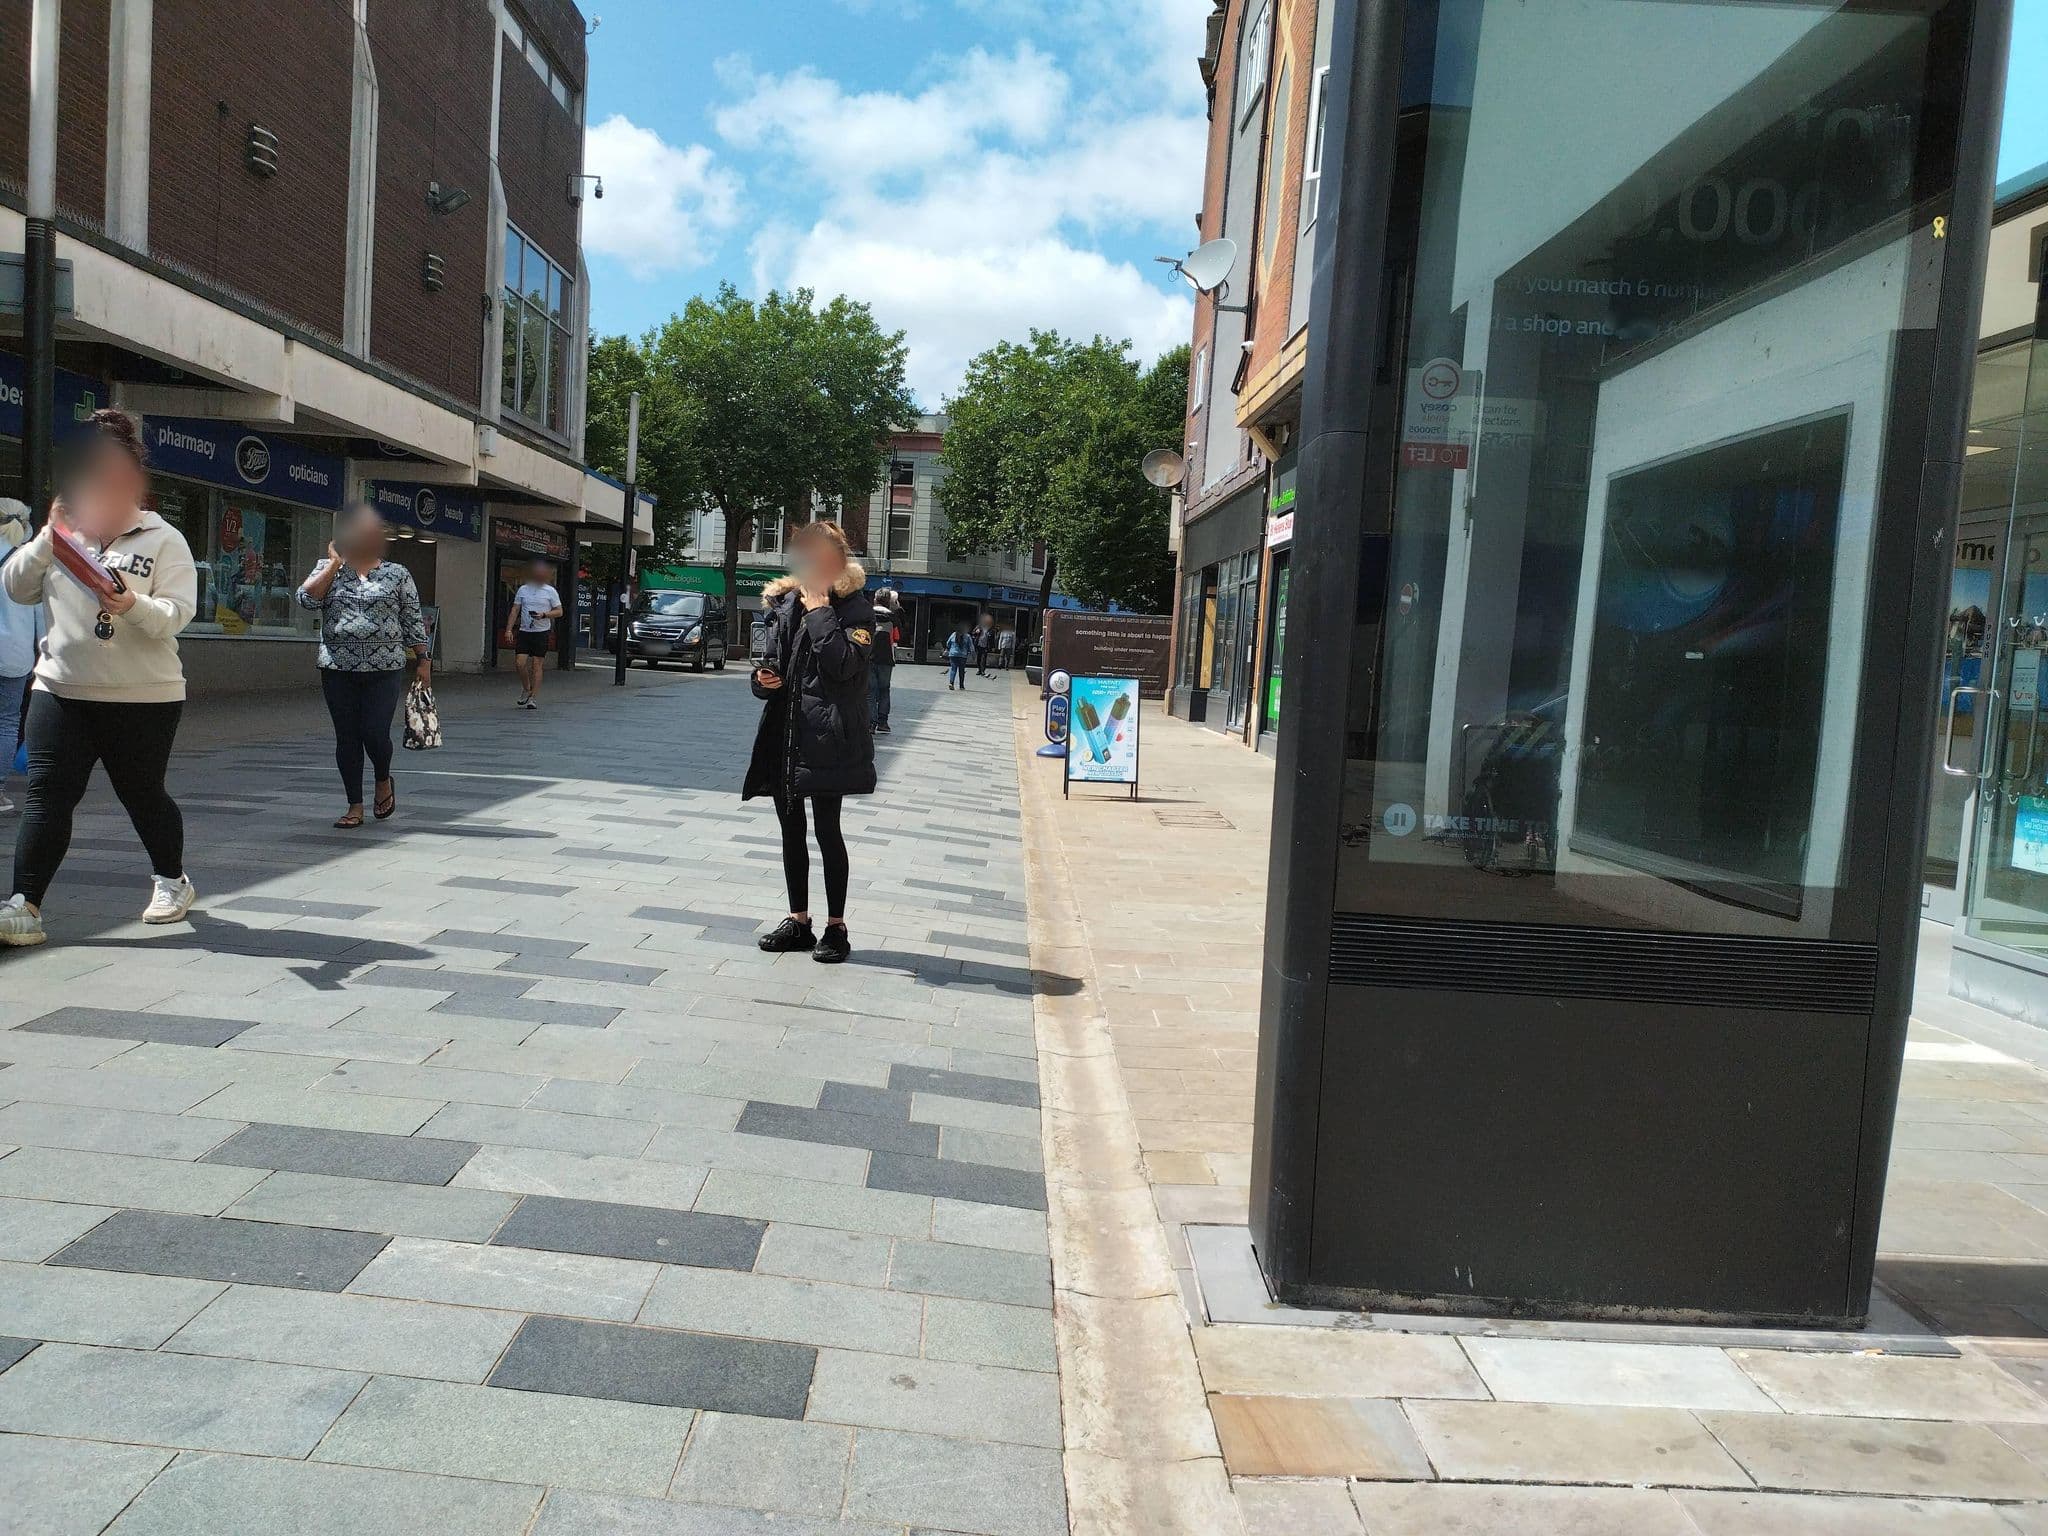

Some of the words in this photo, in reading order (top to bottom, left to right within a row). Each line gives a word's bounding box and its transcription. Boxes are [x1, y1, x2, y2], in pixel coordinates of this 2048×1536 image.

[1526, 278, 1563, 300] you
[1568, 278, 1631, 298] match
[1637, 279, 1650, 297] 6
[1522, 314, 1571, 337] shop
[158, 424, 217, 460] pharmacy
[288, 462, 330, 488] opticians
[377, 486, 412, 512] pharmacy
[1075, 629, 1106, 638] something
[1127, 631, 1144, 639] about
[1051, 704, 1067, 714] Play
[1424, 814, 1471, 831] TAKE
[1474, 815, 1521, 833] TIME
